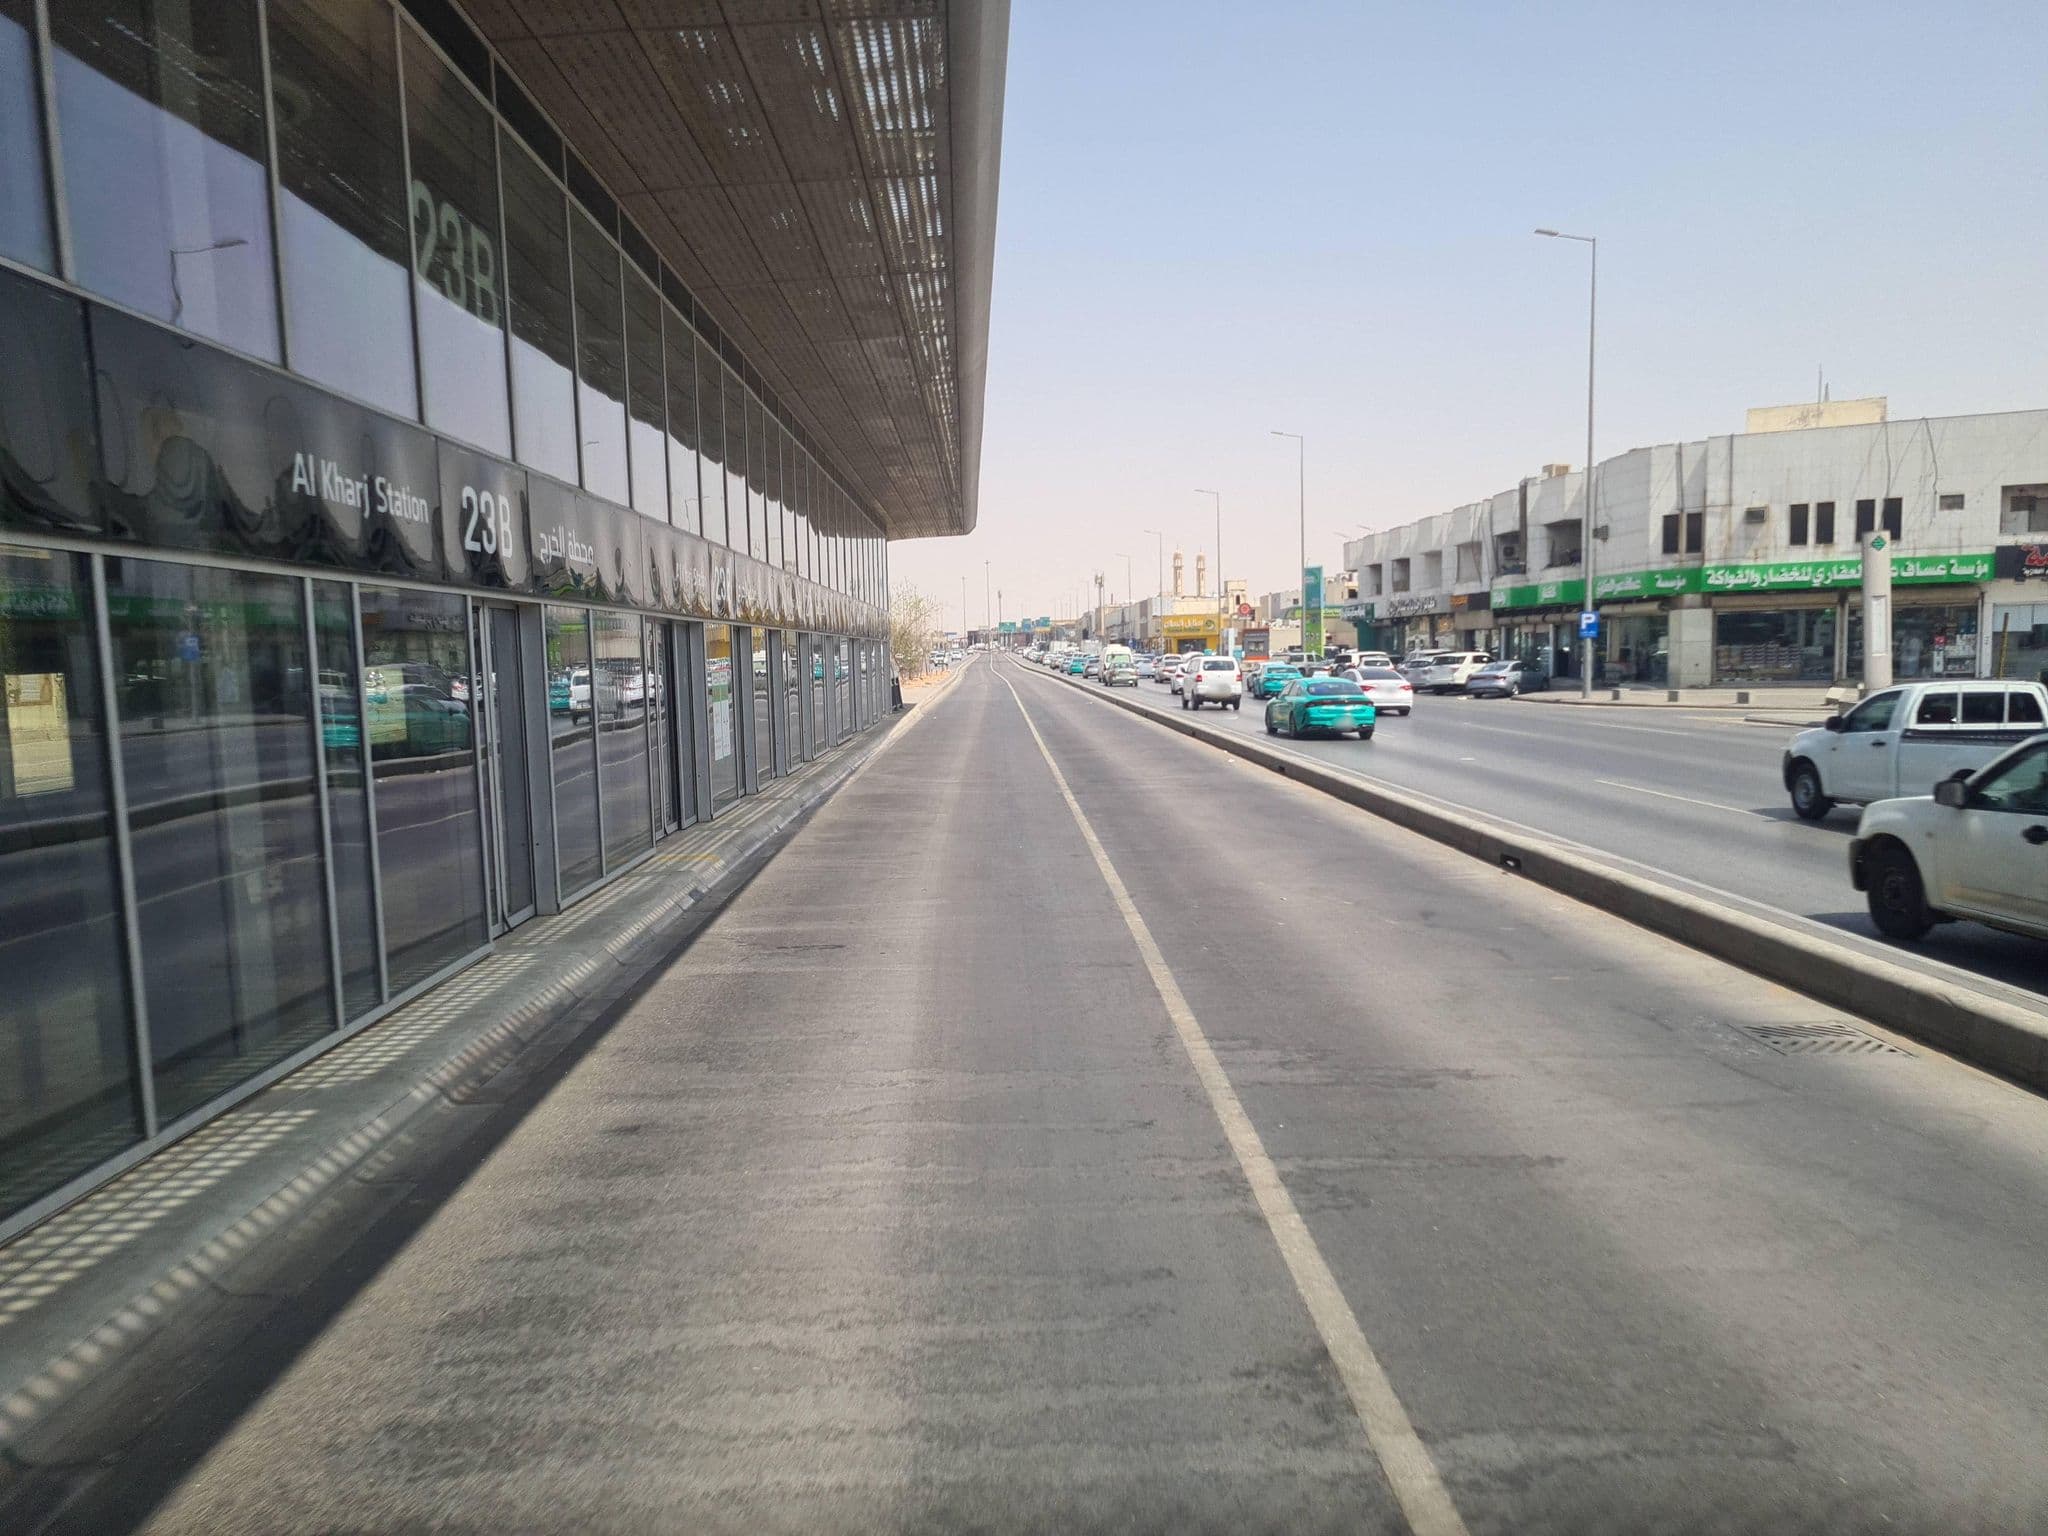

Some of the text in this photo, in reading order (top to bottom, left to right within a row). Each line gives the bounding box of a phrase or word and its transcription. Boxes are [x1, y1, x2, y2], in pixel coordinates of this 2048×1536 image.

[292, 451, 430, 523] Al Kharj Station
[461, 485, 513, 558] 23B
[540, 523, 594, 565] محطة الخرج
[1812, 563, 1863, 586] لعقاري
